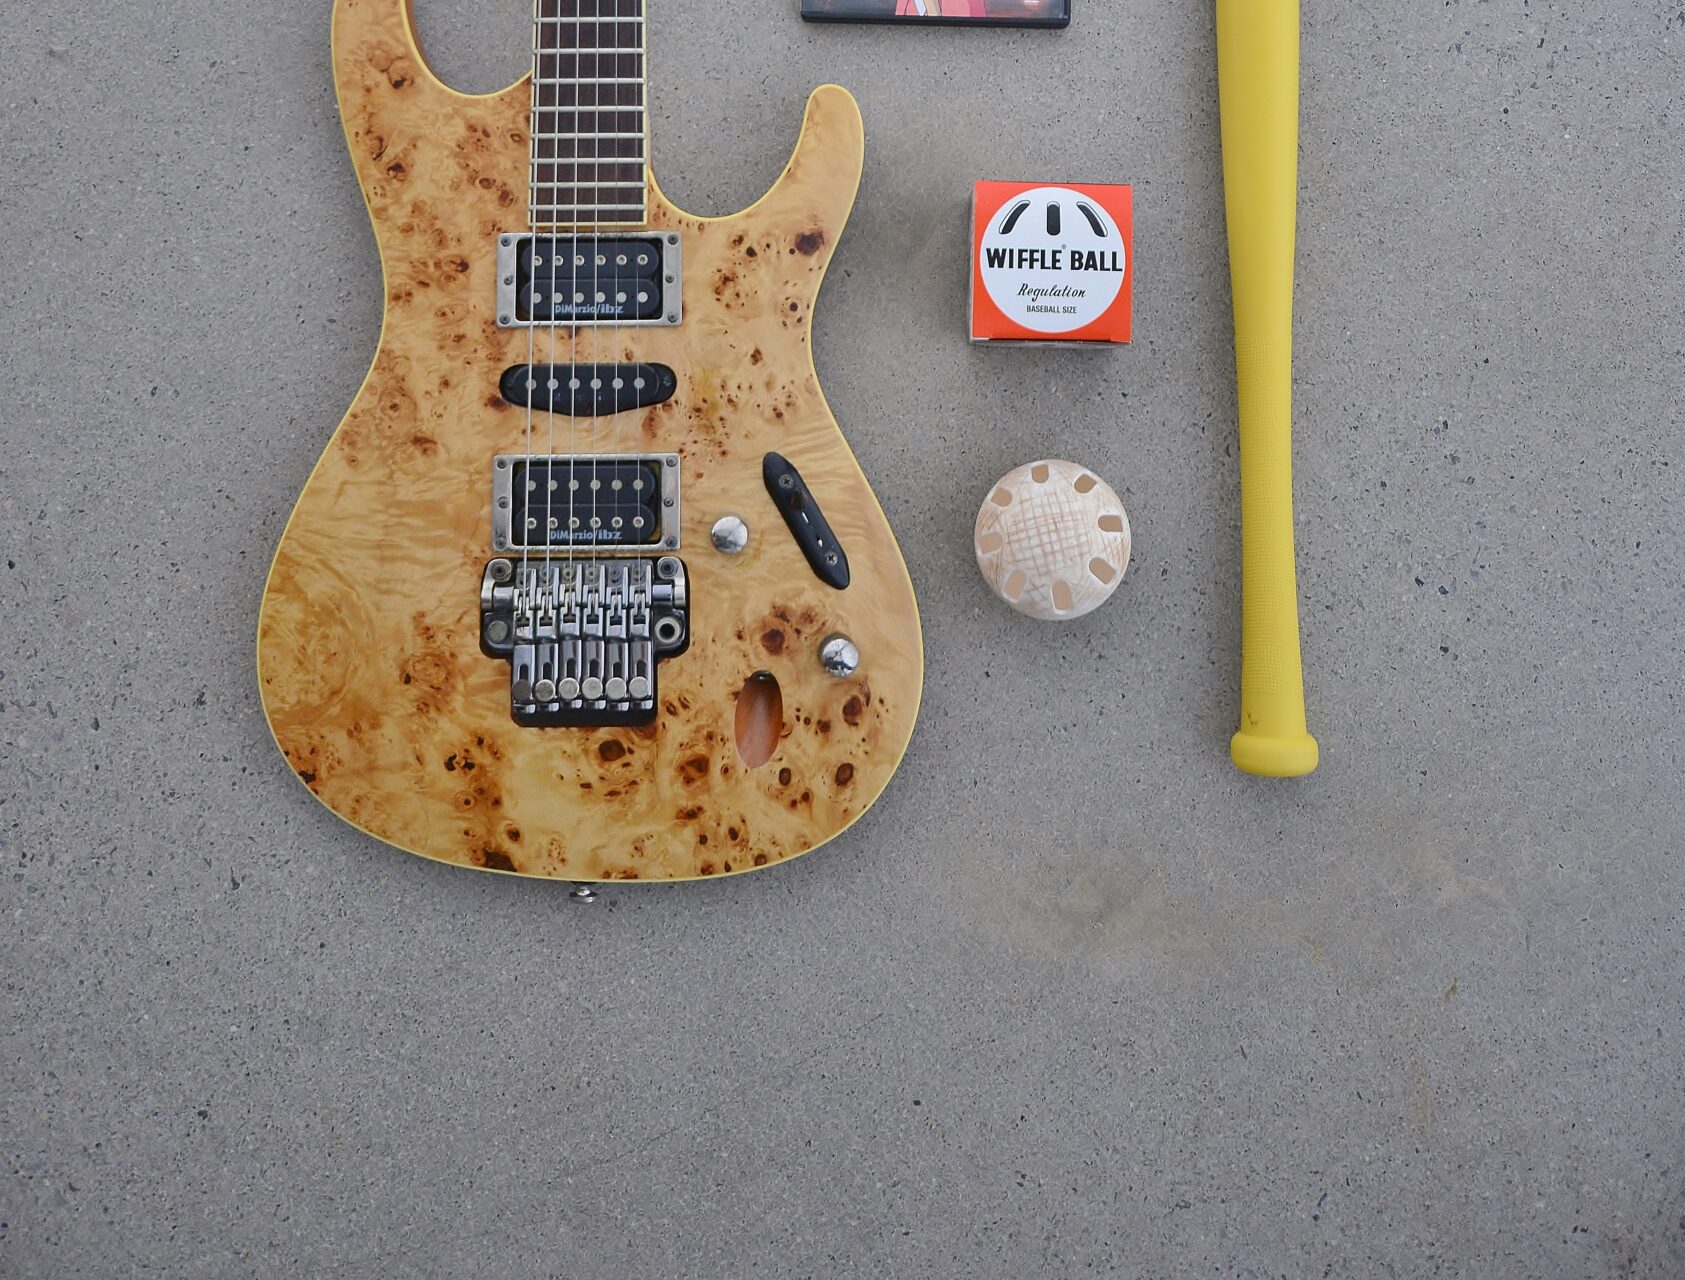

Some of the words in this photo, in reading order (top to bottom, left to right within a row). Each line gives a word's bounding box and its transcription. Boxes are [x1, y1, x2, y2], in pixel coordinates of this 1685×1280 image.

[986, 248, 1062, 270] WIFFLE
[1070, 250, 1123, 272] BALL
[1016, 283, 1087, 302] Regulation
[1026, 305, 1060, 313] BASEBALL
